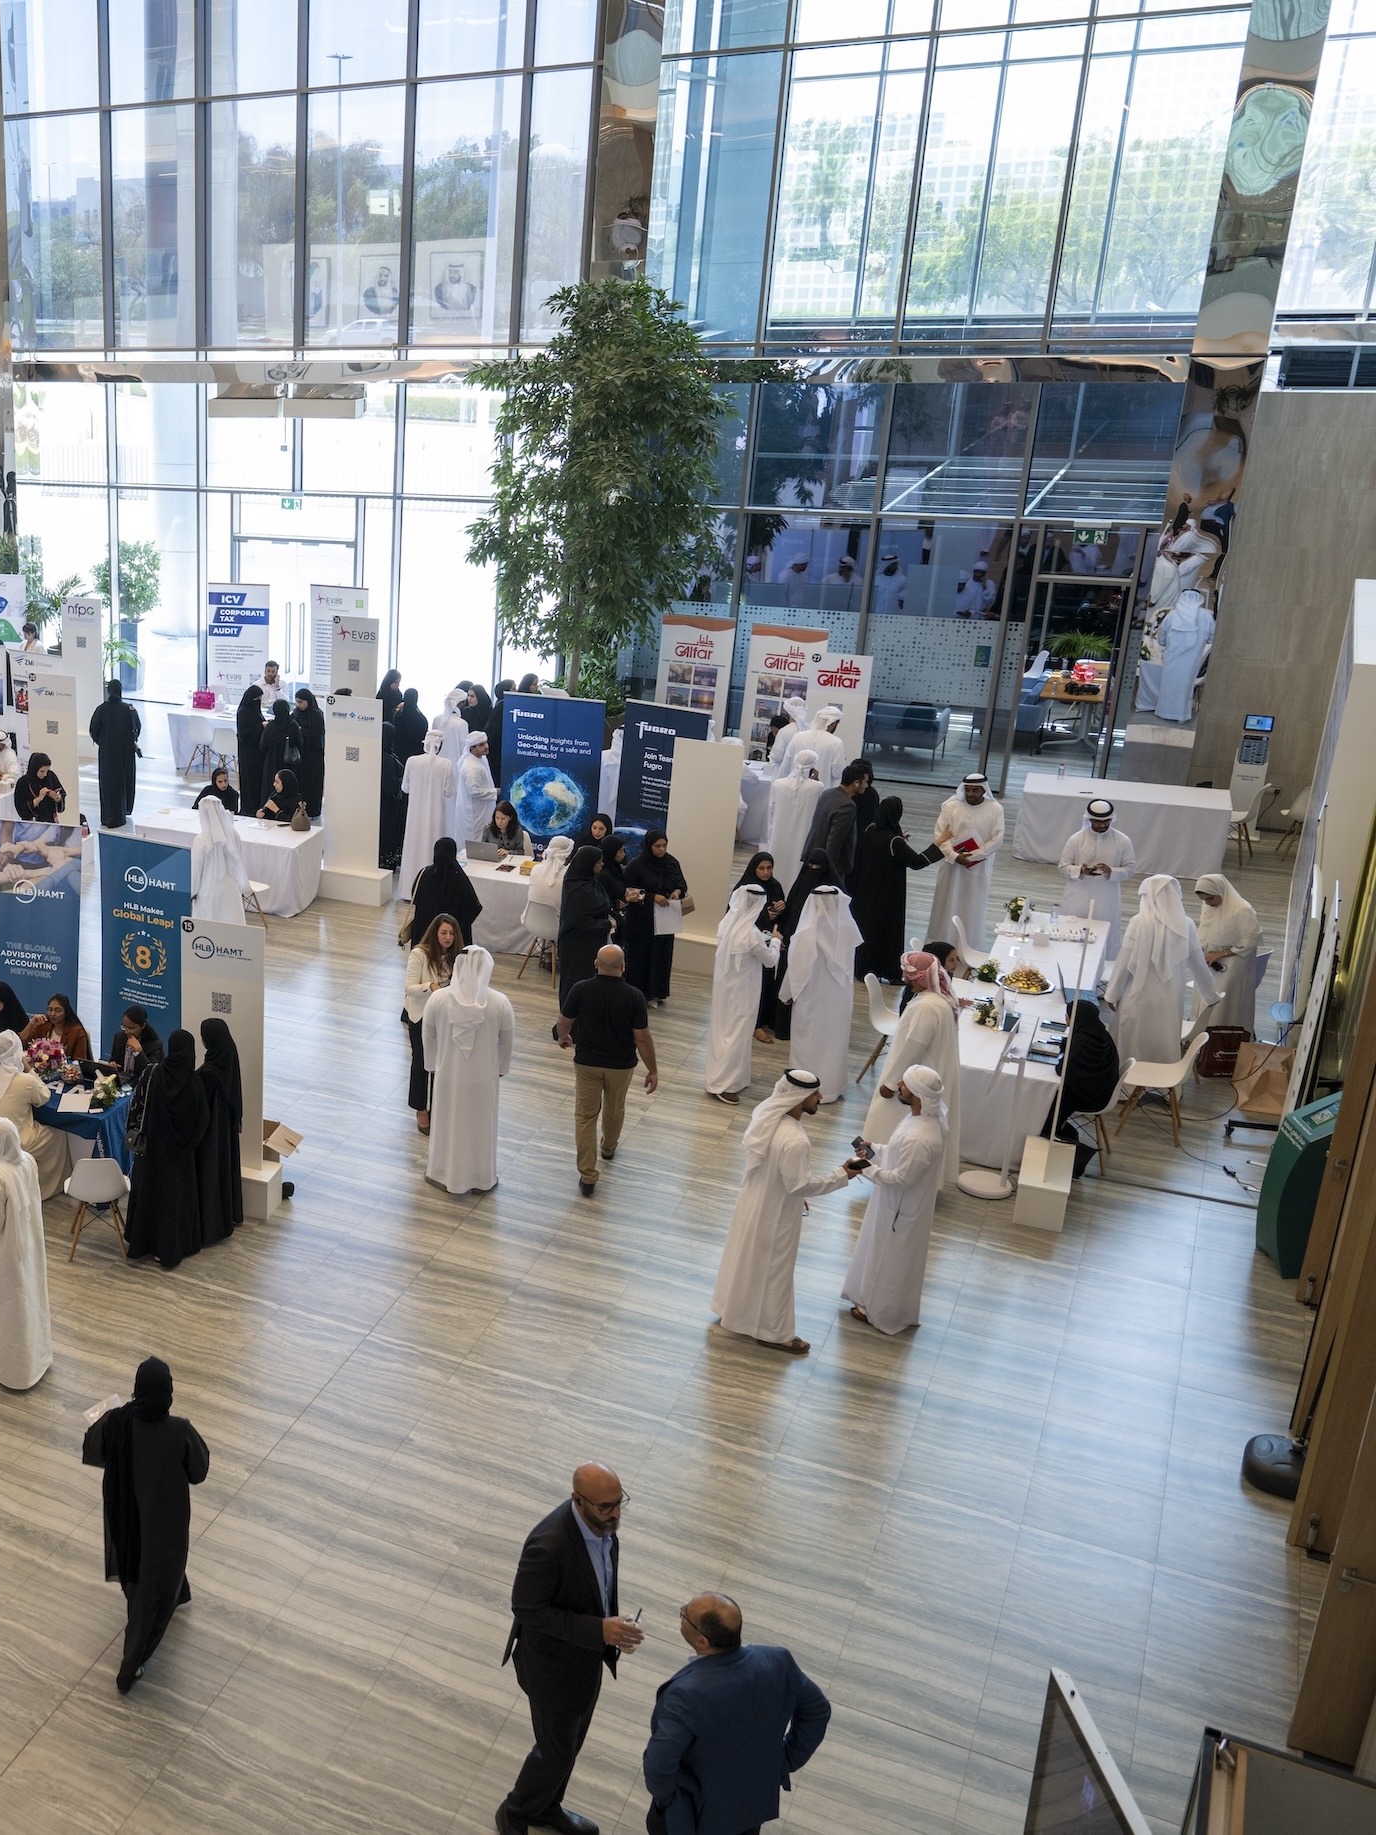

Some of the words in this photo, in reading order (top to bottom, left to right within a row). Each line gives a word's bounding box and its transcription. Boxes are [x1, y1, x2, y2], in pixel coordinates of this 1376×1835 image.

[221, 595, 240, 604] ICV
[68, 604, 94, 617] nfpc
[518, 733, 549, 743] Unlocking
[550, 737, 573, 746] insights
[517, 741, 548, 751] Geo-data,
[517, 749, 539, 757] liveable
[644, 752, 658, 761] Join
[644, 761, 663, 771] Fugro
[149, 878, 176, 891] HAMT
[38, 889, 65, 899] HAMT
[124, 902, 139, 910] HLB
[140, 905, 164, 915] Makes
[113, 909, 144, 922] Global
[147, 915, 174, 928] Leap!
[24, 944, 56, 954] GLOBAL
[216, 946, 243, 956] HAMT
[0, 950, 42, 960] ADVISORY
[44, 954, 61, 962] AND
[136, 945, 152, 969] 8
[4, 959, 57, 970] ACCOUNTING
[10, 967, 52, 978] NETWORK
